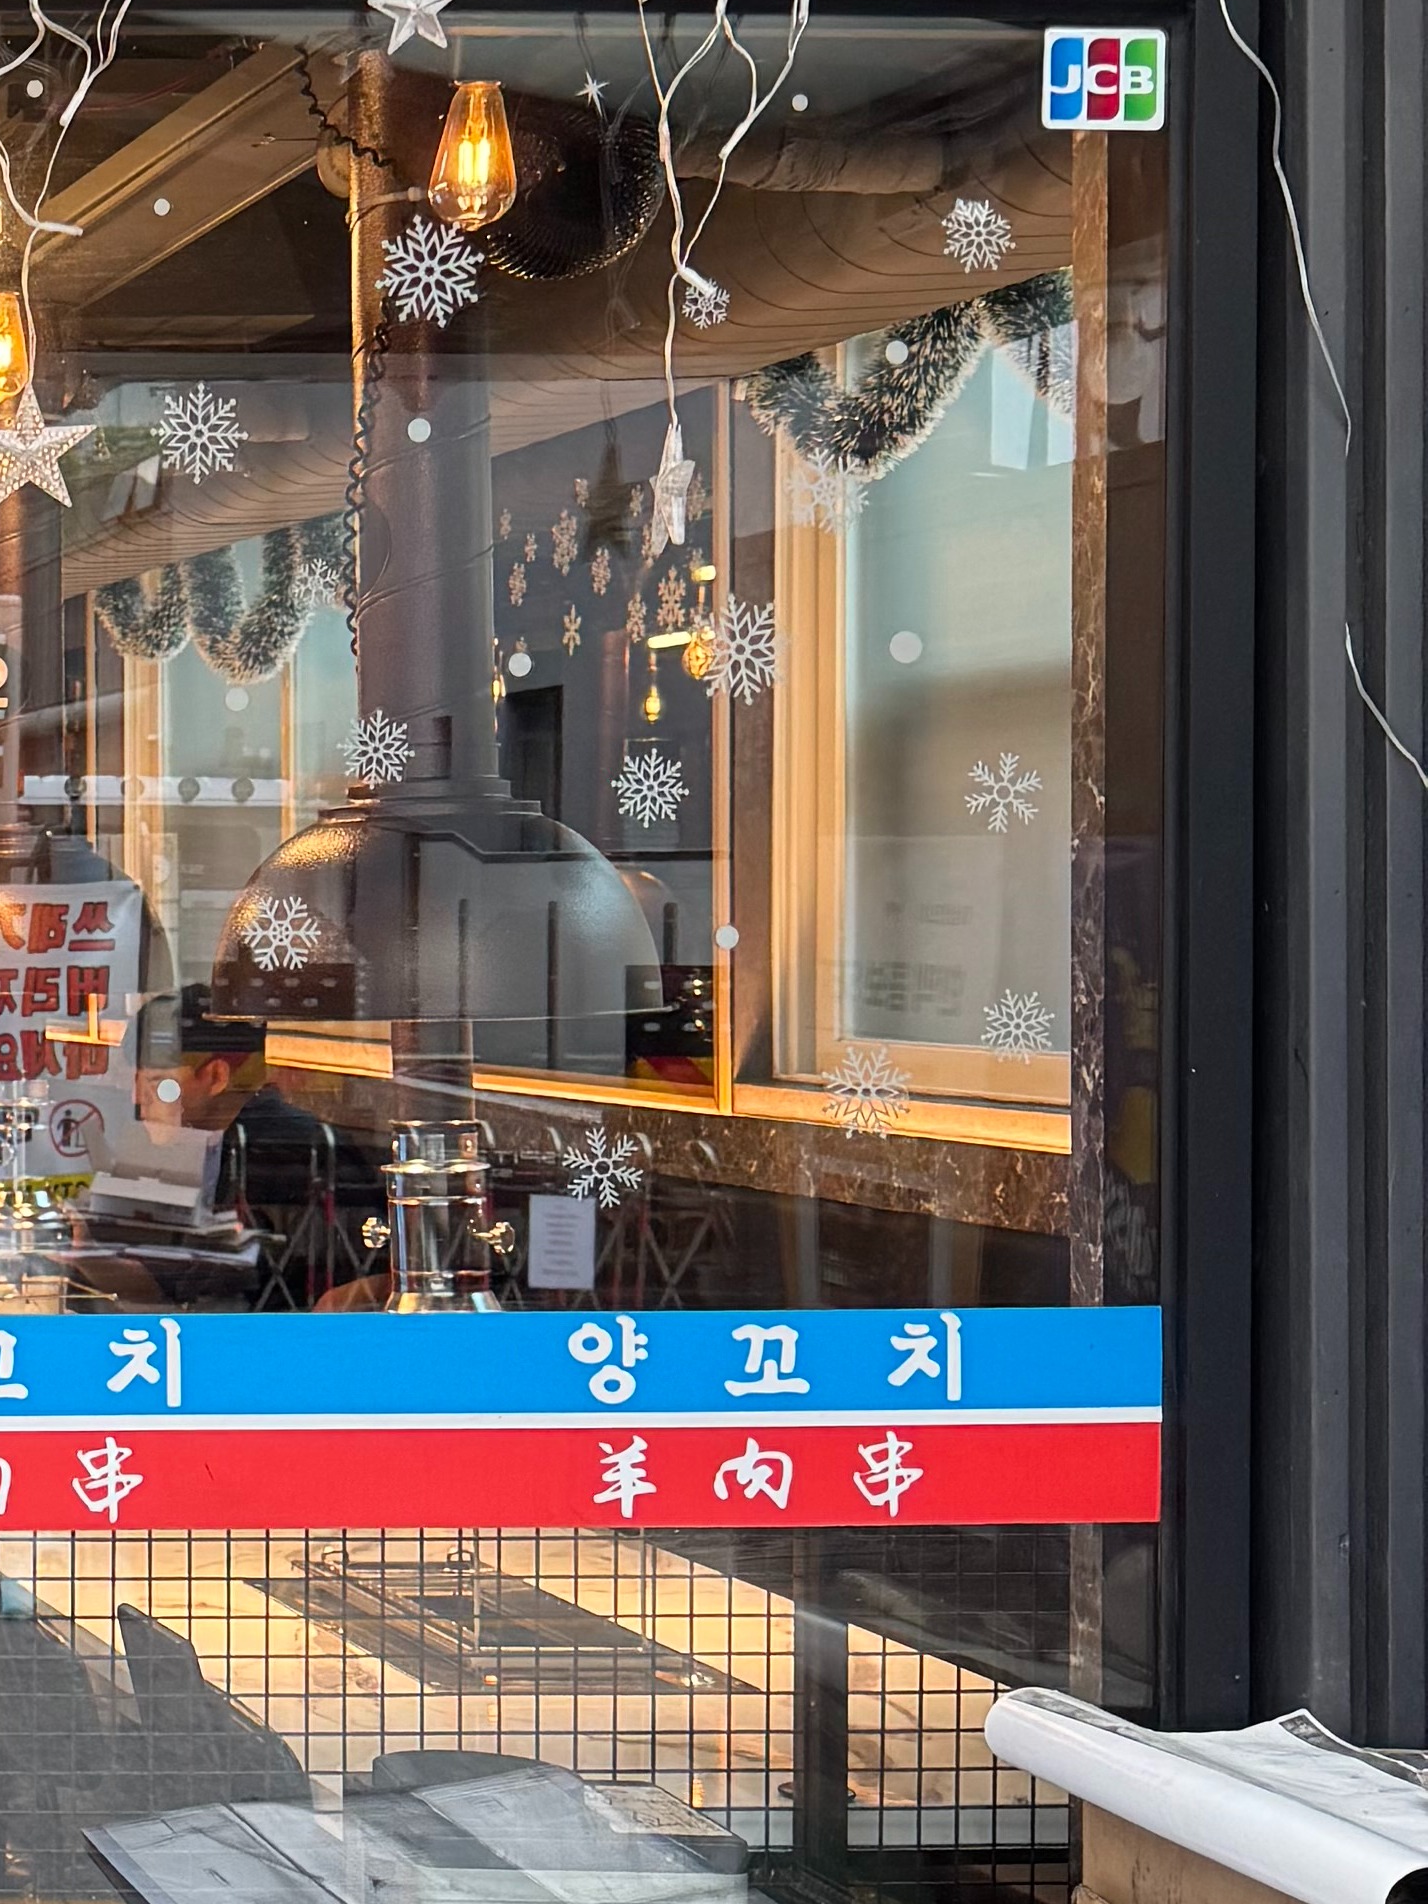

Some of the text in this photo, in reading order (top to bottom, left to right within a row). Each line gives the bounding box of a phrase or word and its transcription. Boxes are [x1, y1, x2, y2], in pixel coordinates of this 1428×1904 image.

[1049, 64, 1155, 95] JCB
[569, 1313, 960, 1403] 양꼬치
[594, 1432, 922, 1517] 羊肉串
